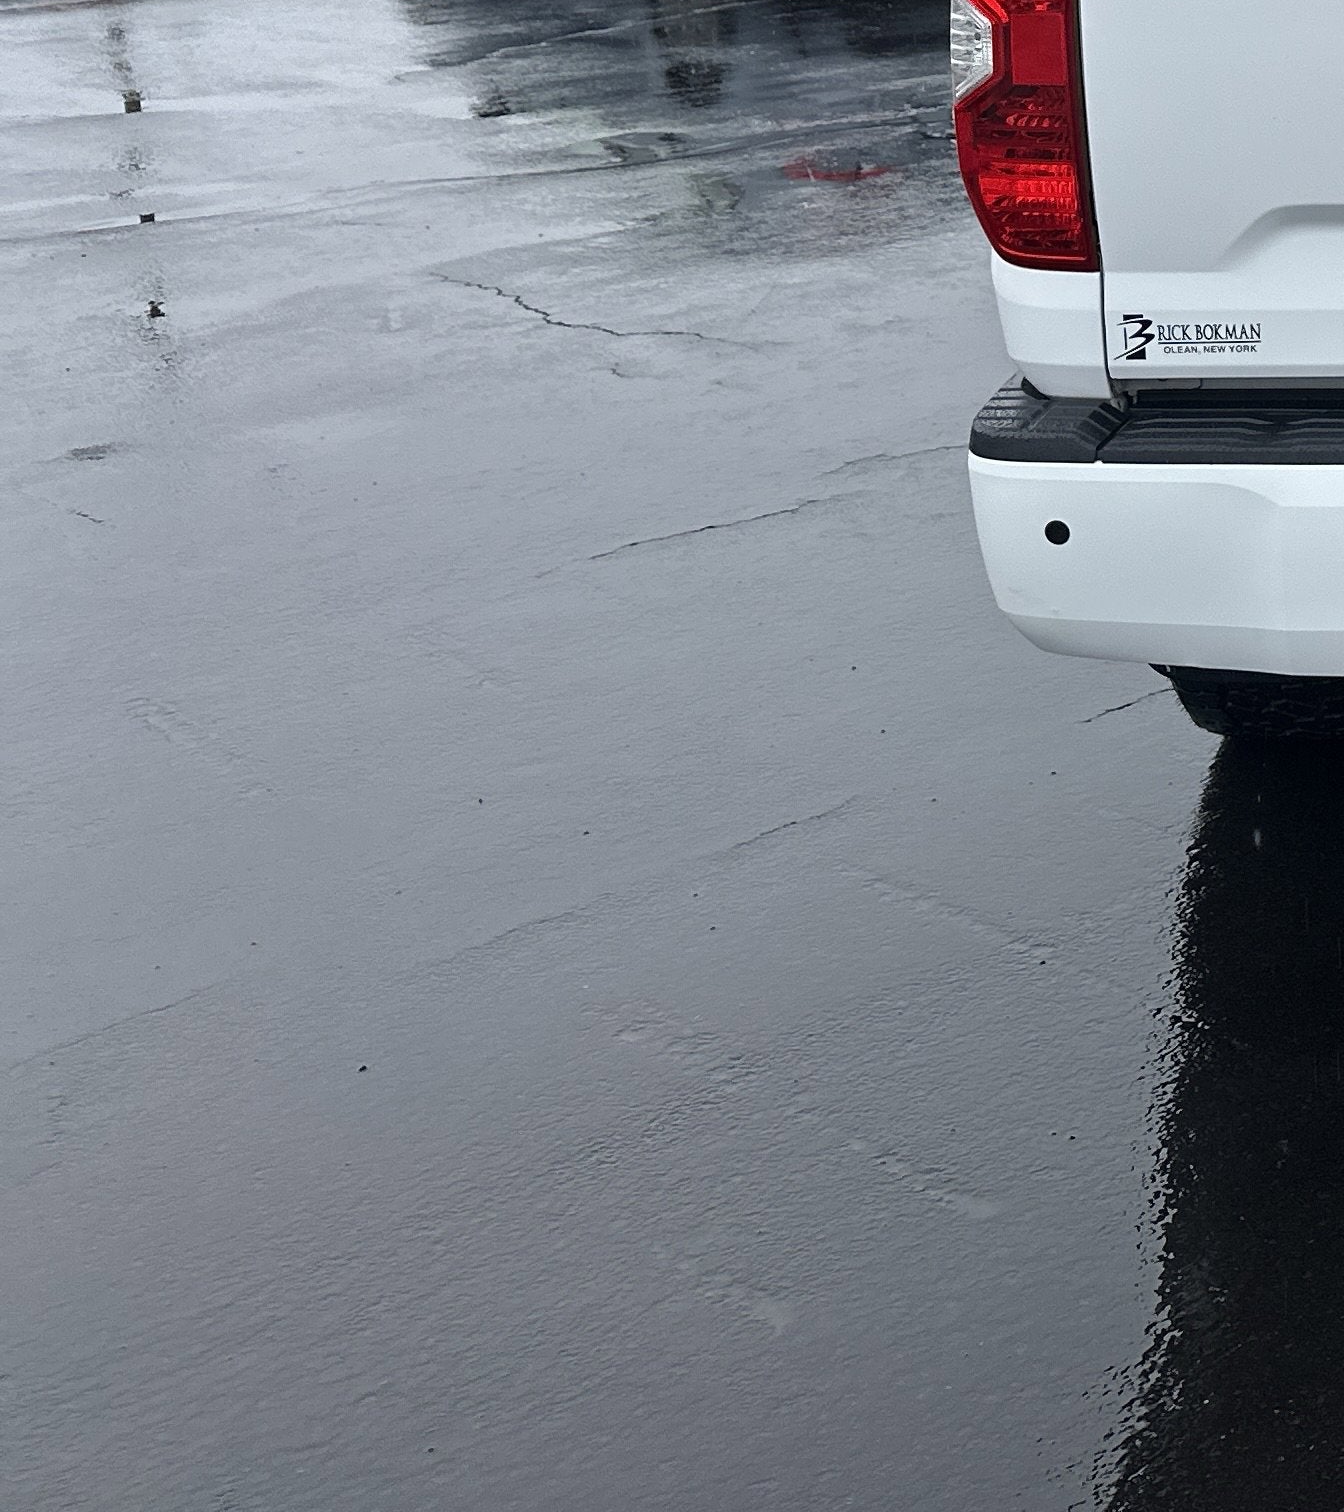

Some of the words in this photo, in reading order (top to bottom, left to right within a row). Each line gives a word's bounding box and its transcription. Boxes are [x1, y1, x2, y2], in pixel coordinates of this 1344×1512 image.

[1156, 324, 1192, 341] RICK
[1195, 323, 1262, 341] BOKMAN
[1203, 345, 1227, 354] NEW
[1228, 344, 1258, 354] YORK
